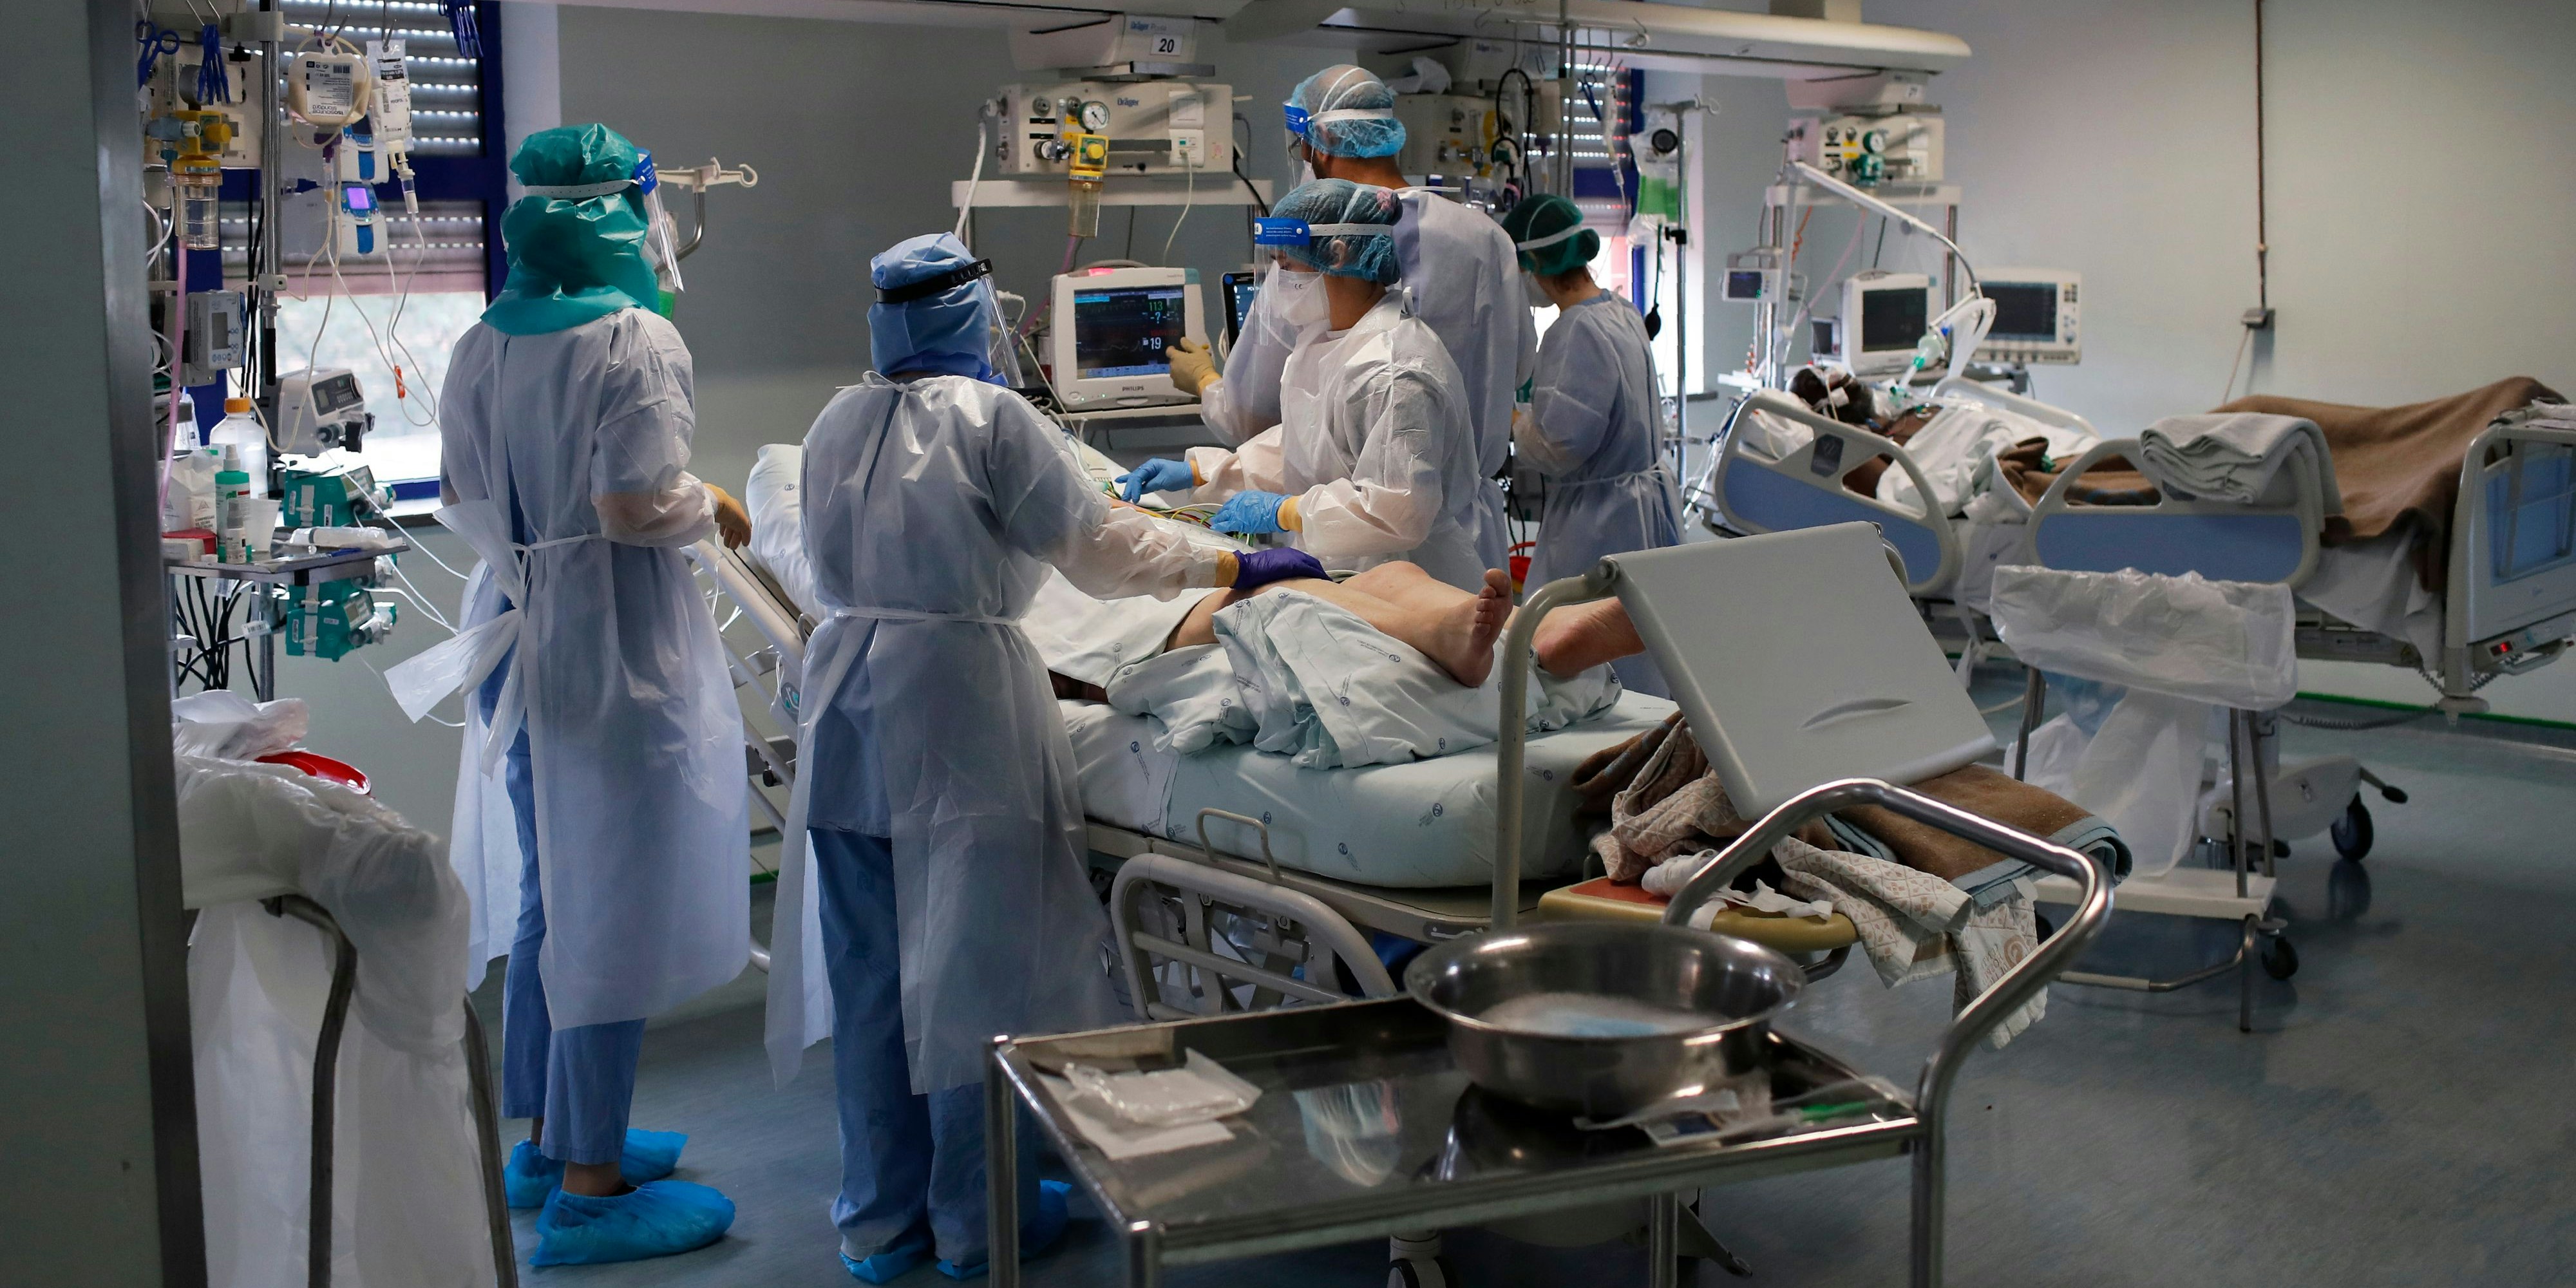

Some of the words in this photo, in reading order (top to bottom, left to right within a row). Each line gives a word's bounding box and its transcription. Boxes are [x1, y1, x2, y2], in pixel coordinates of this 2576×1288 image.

[1159, 38, 1174, 53] 20
[1117, 97, 1139, 106] Dräger
[1149, 301, 1163, 311] 113
[1150, 337, 1161, 350] 19
